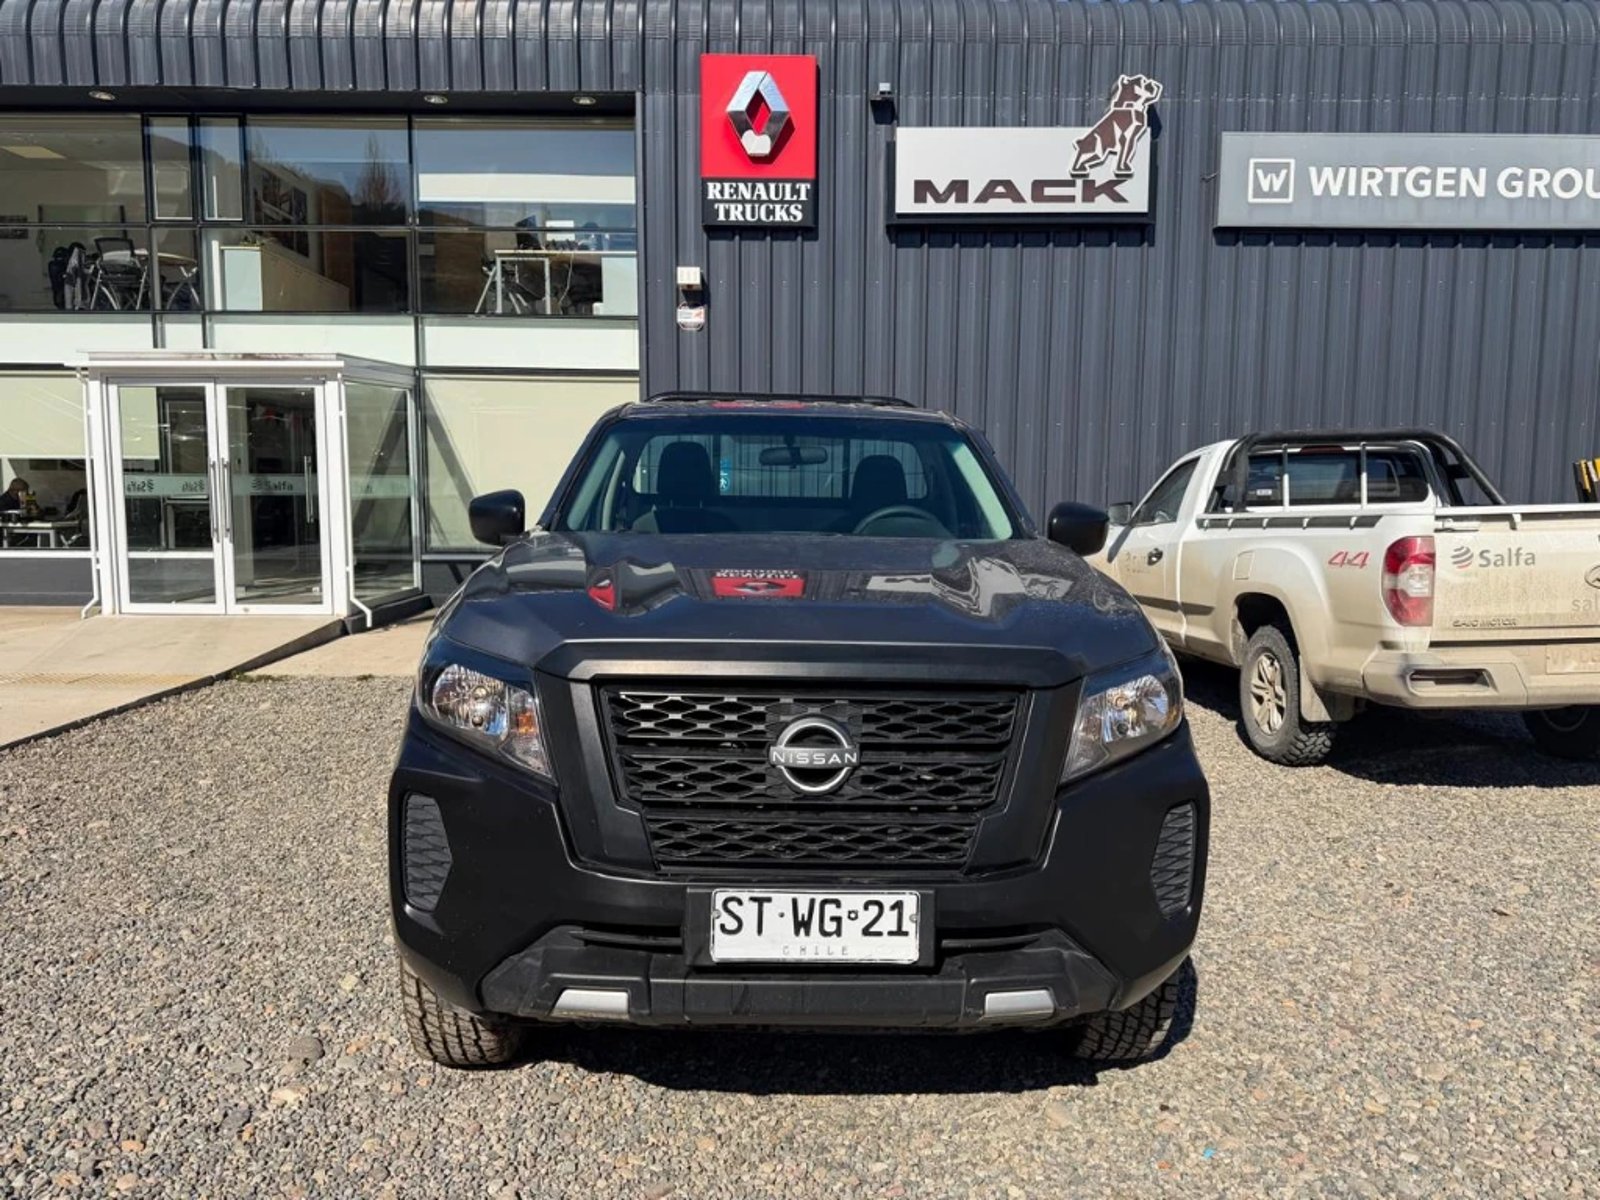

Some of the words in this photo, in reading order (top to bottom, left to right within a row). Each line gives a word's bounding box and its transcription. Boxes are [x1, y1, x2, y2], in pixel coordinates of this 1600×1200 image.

[706, 182, 810, 201] RENAULT
[913, 179, 1129, 204] MACK
[1309, 166, 1487, 198] WIRTGEN
[714, 203, 804, 223] TRUCKS
[1478, 547, 1536, 568] Salfa
[772, 751, 858, 764] NISSAN
[782, 945, 849, 956] CHILE
